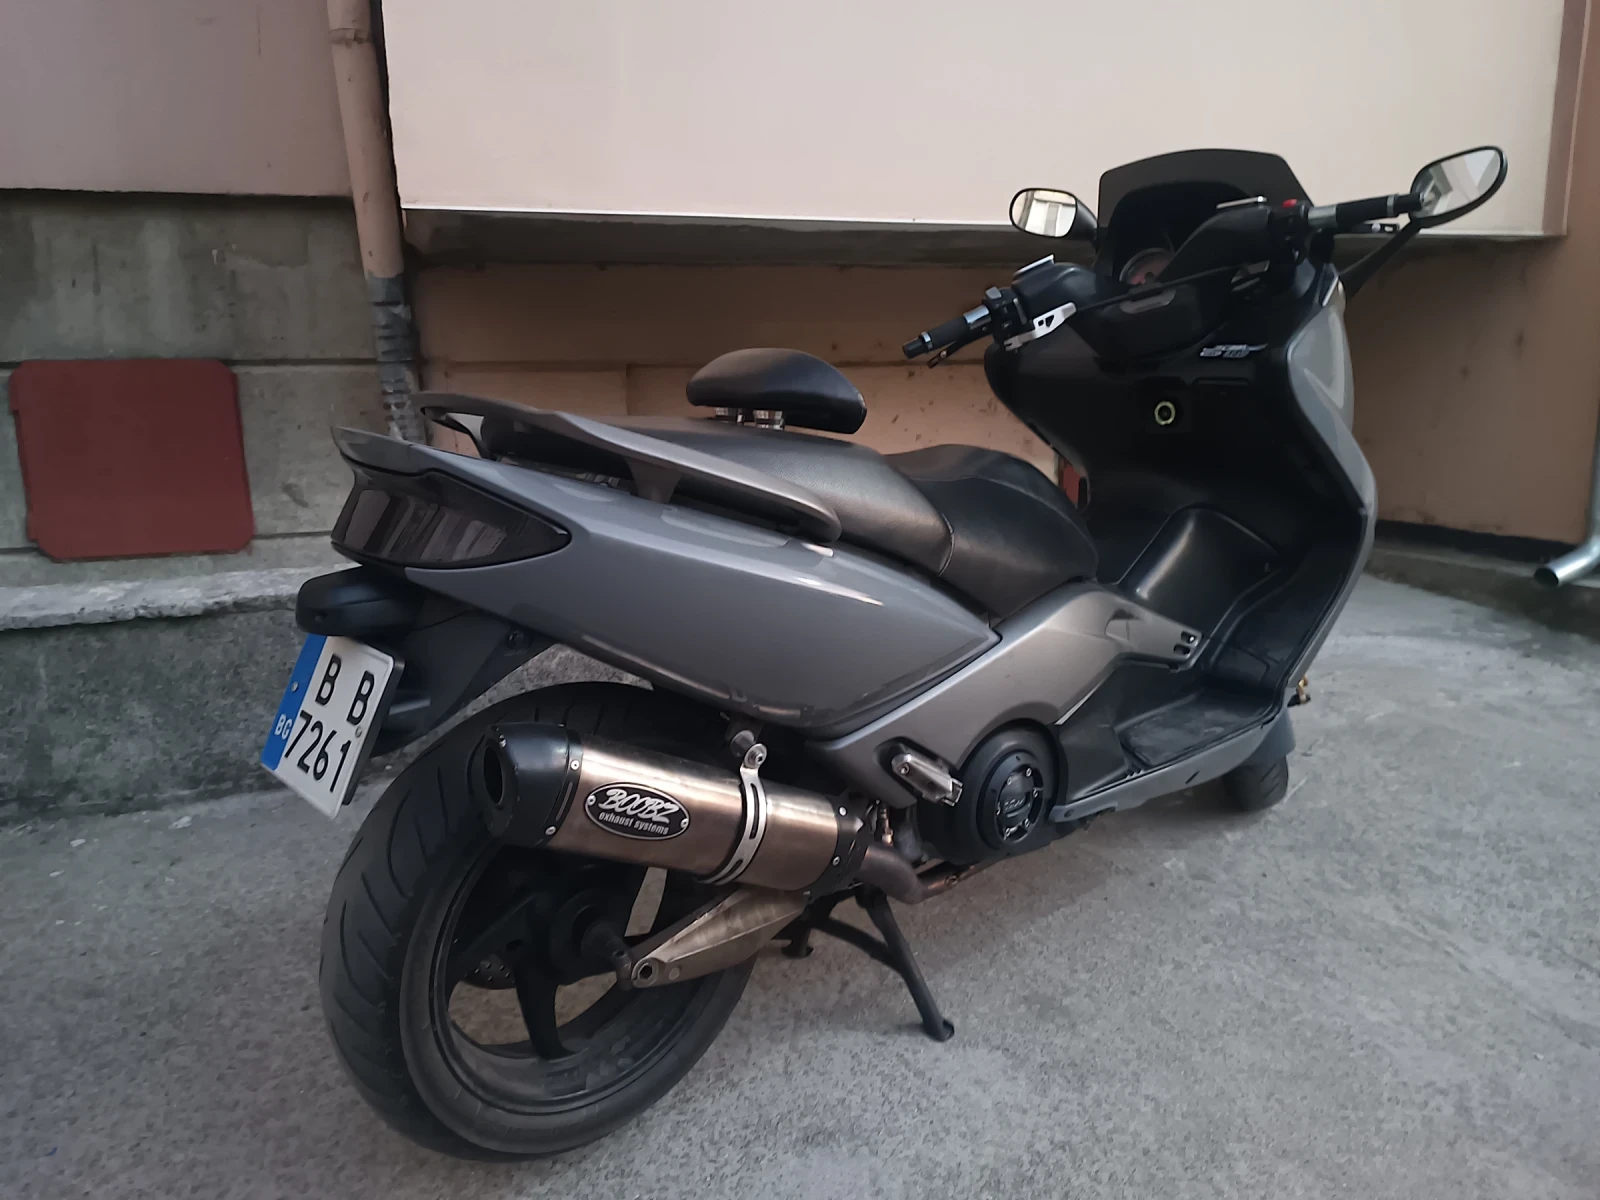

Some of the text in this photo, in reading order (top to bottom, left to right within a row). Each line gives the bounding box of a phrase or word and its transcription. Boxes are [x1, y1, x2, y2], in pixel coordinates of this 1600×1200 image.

[315, 653, 374, 725] B B
[275, 714, 293, 739] BG
[284, 710, 351, 792] 7261
[598, 788, 680, 824] BOOBZ
[598, 812, 670, 835] exhaust systems
